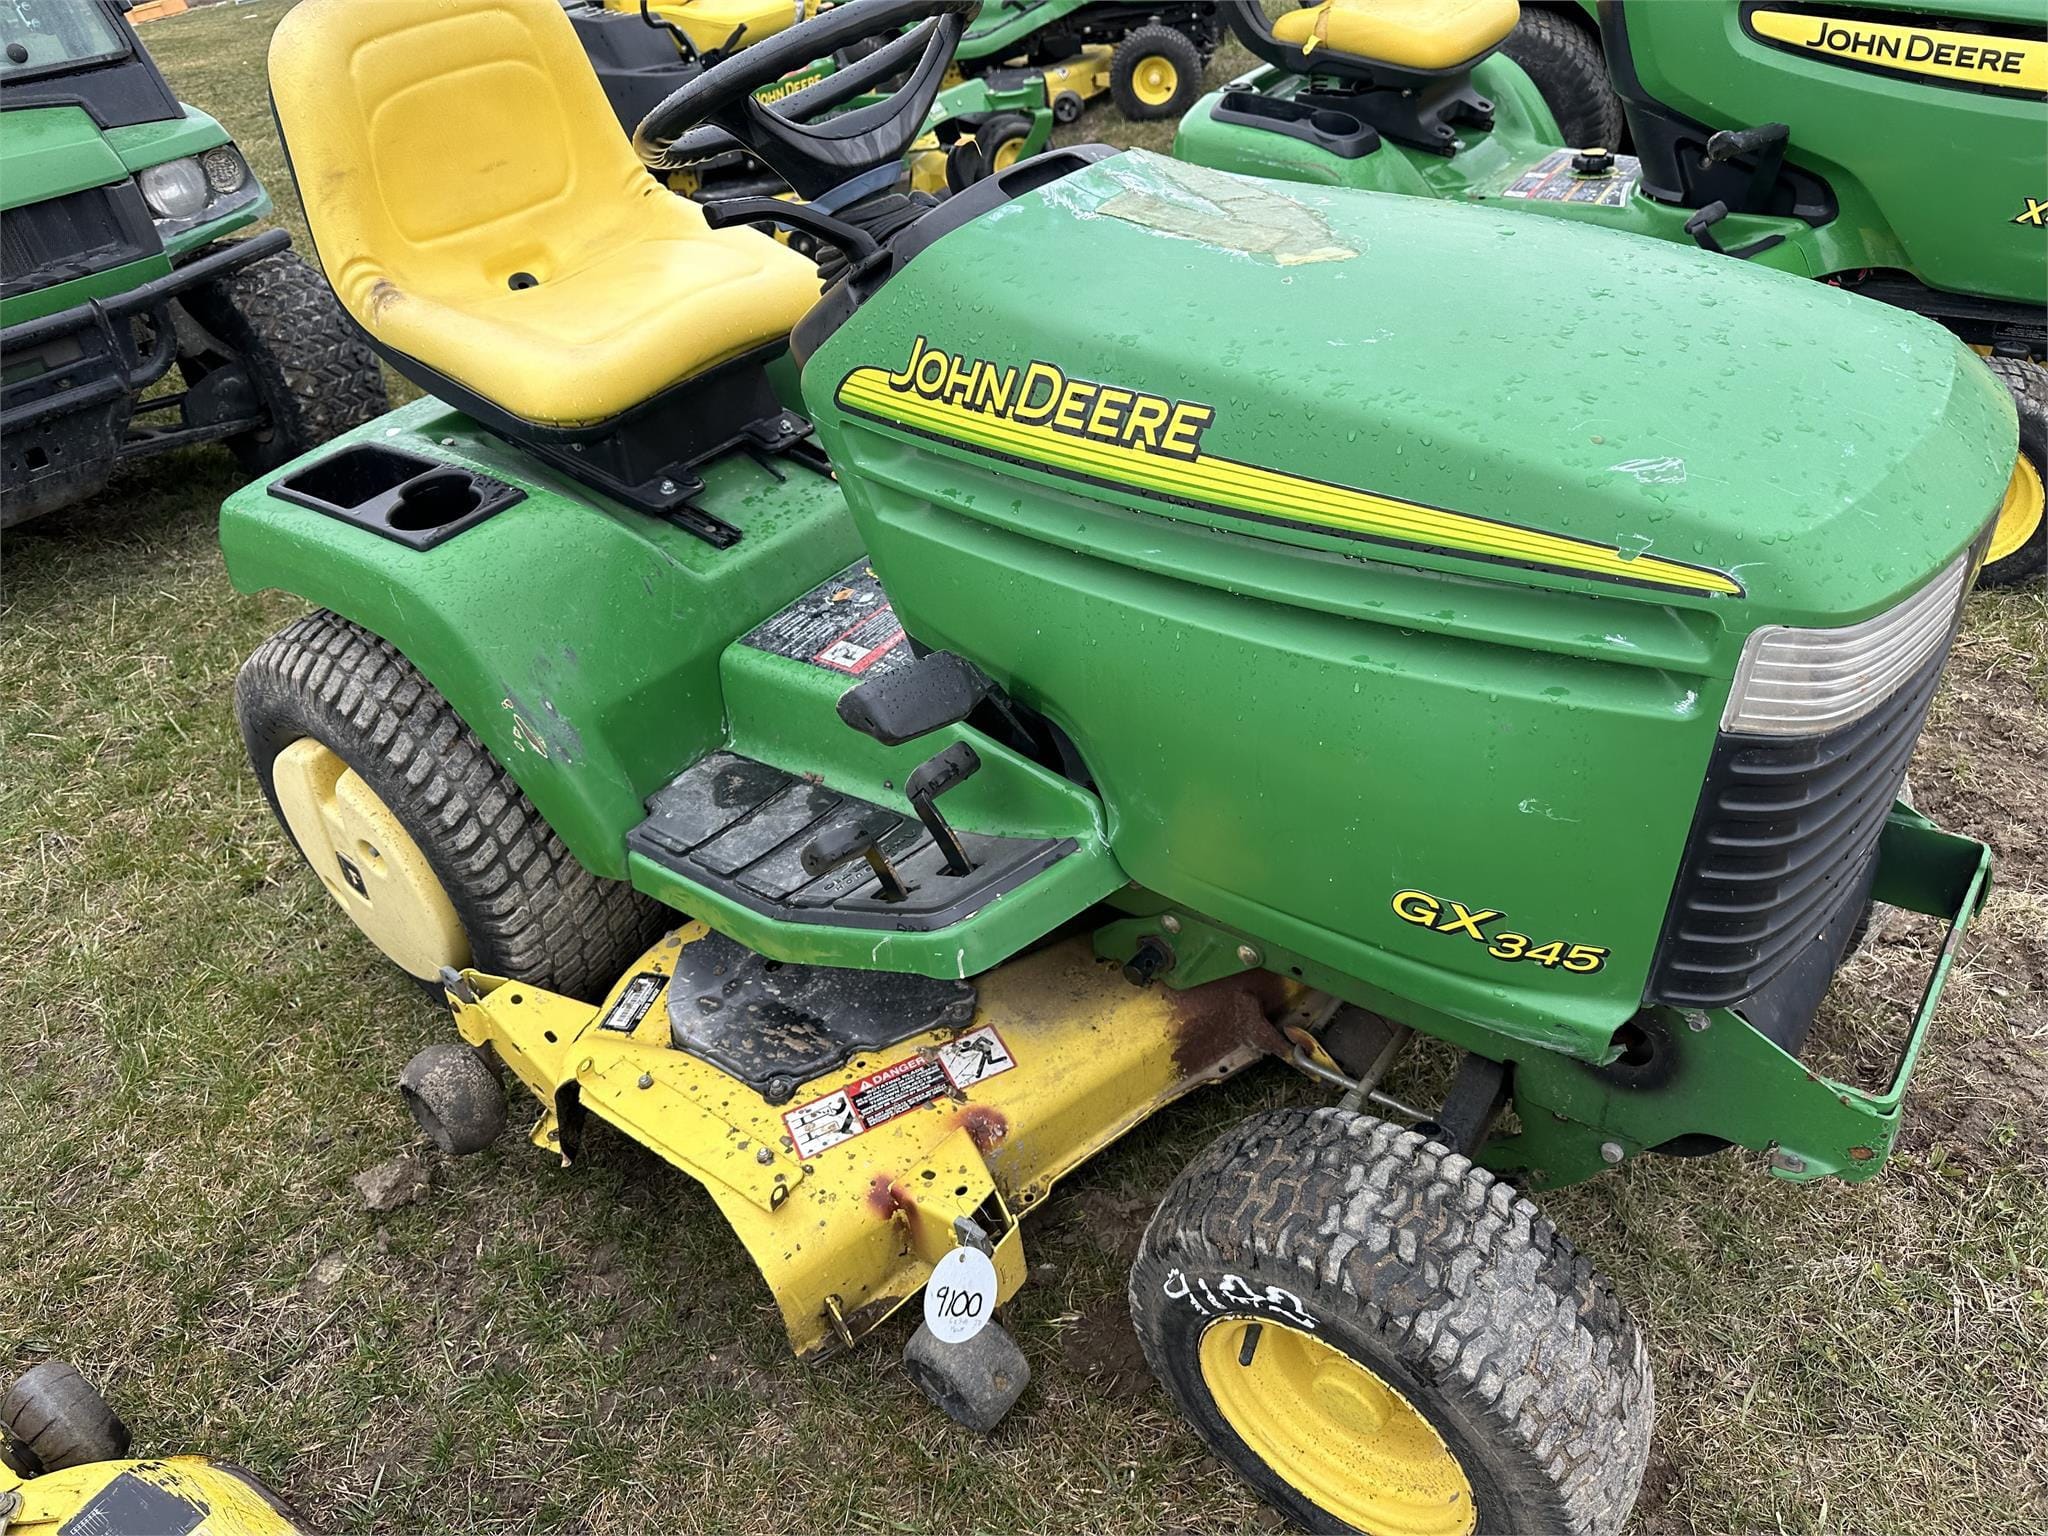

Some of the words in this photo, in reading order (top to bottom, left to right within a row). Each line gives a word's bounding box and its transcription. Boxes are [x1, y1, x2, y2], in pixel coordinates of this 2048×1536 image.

[1806, 22, 1901, 58] JOHN
[1905, 34, 2025, 74] DEERE
[889, 335, 1020, 418] JOHN
[1012, 360, 1216, 462] DEERE
[1391, 890, 1508, 944] GX
[1487, 932, 1612, 975] 345
[871, 1055, 926, 1084] DANGER
[937, 1286, 982, 1317] 9100
